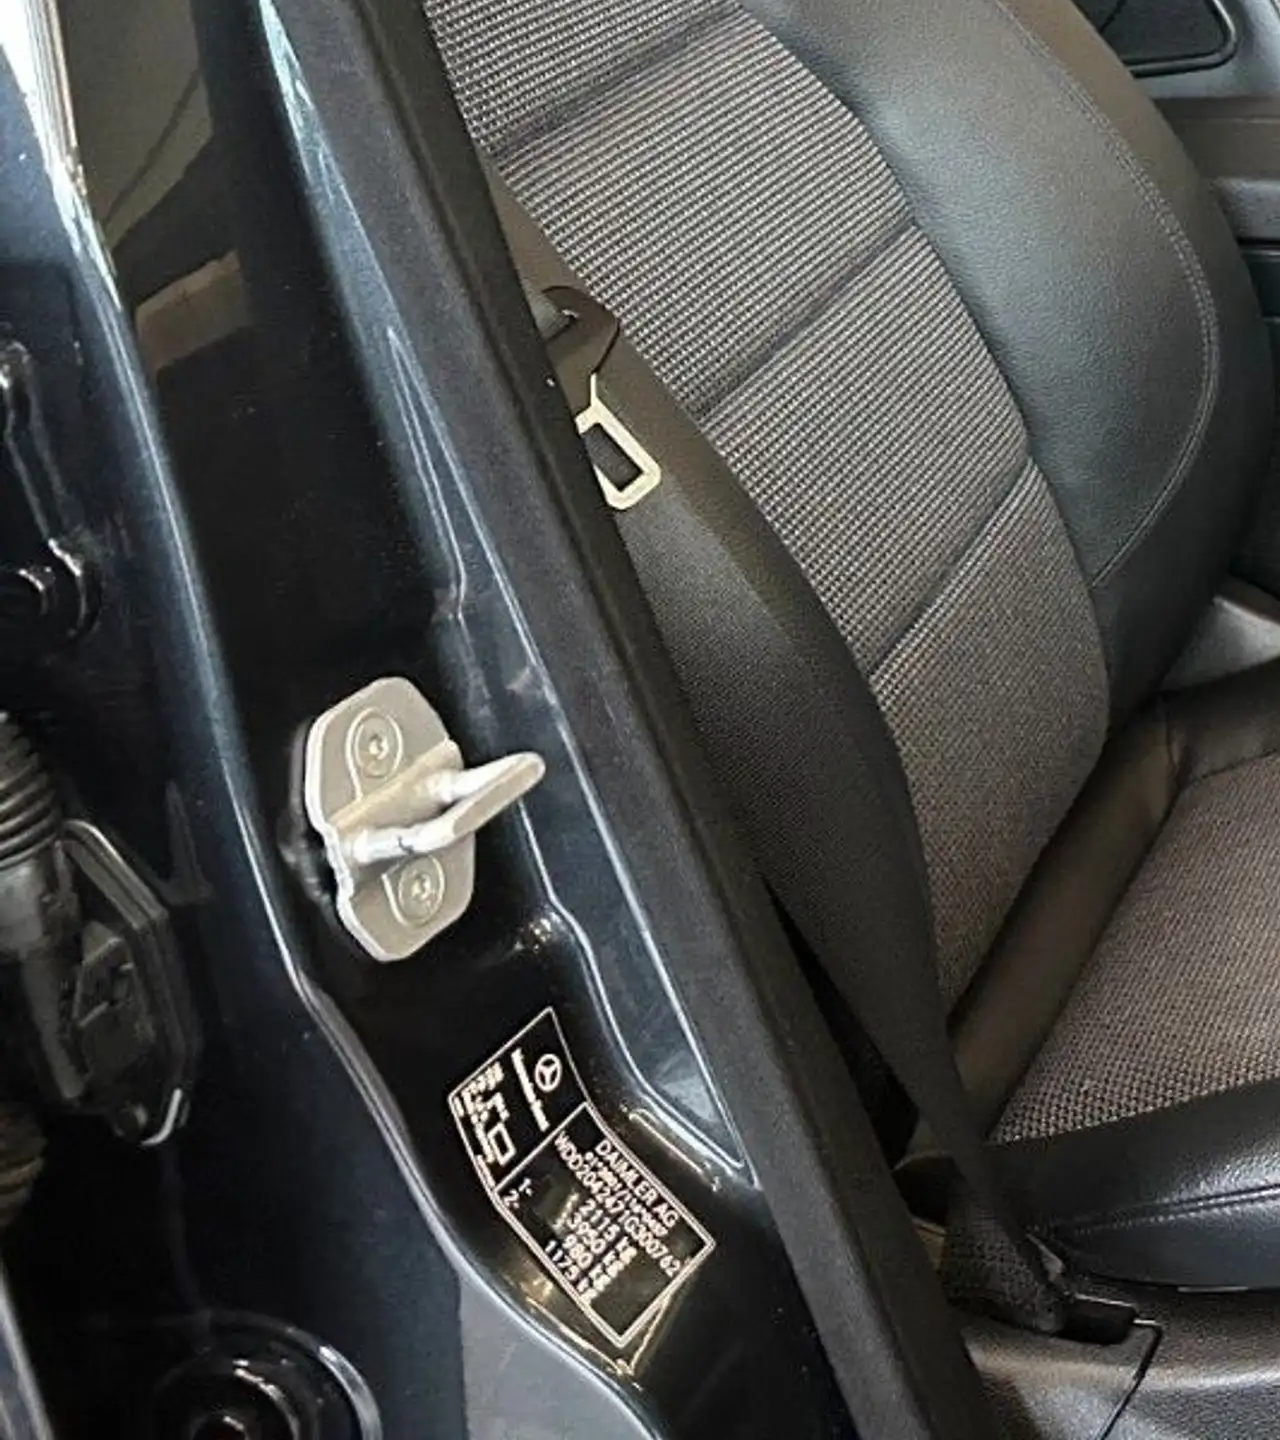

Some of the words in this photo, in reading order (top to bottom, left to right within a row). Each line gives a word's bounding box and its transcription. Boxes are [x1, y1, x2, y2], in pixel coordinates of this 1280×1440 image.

[595, 1139, 658, 1206] DAIMLER
[652, 1201, 680, 1229] AG
[602, 1250, 625, 1278] kg
[616, 1236, 638, 1264] kg
[588, 1265, 612, 1292] kg
